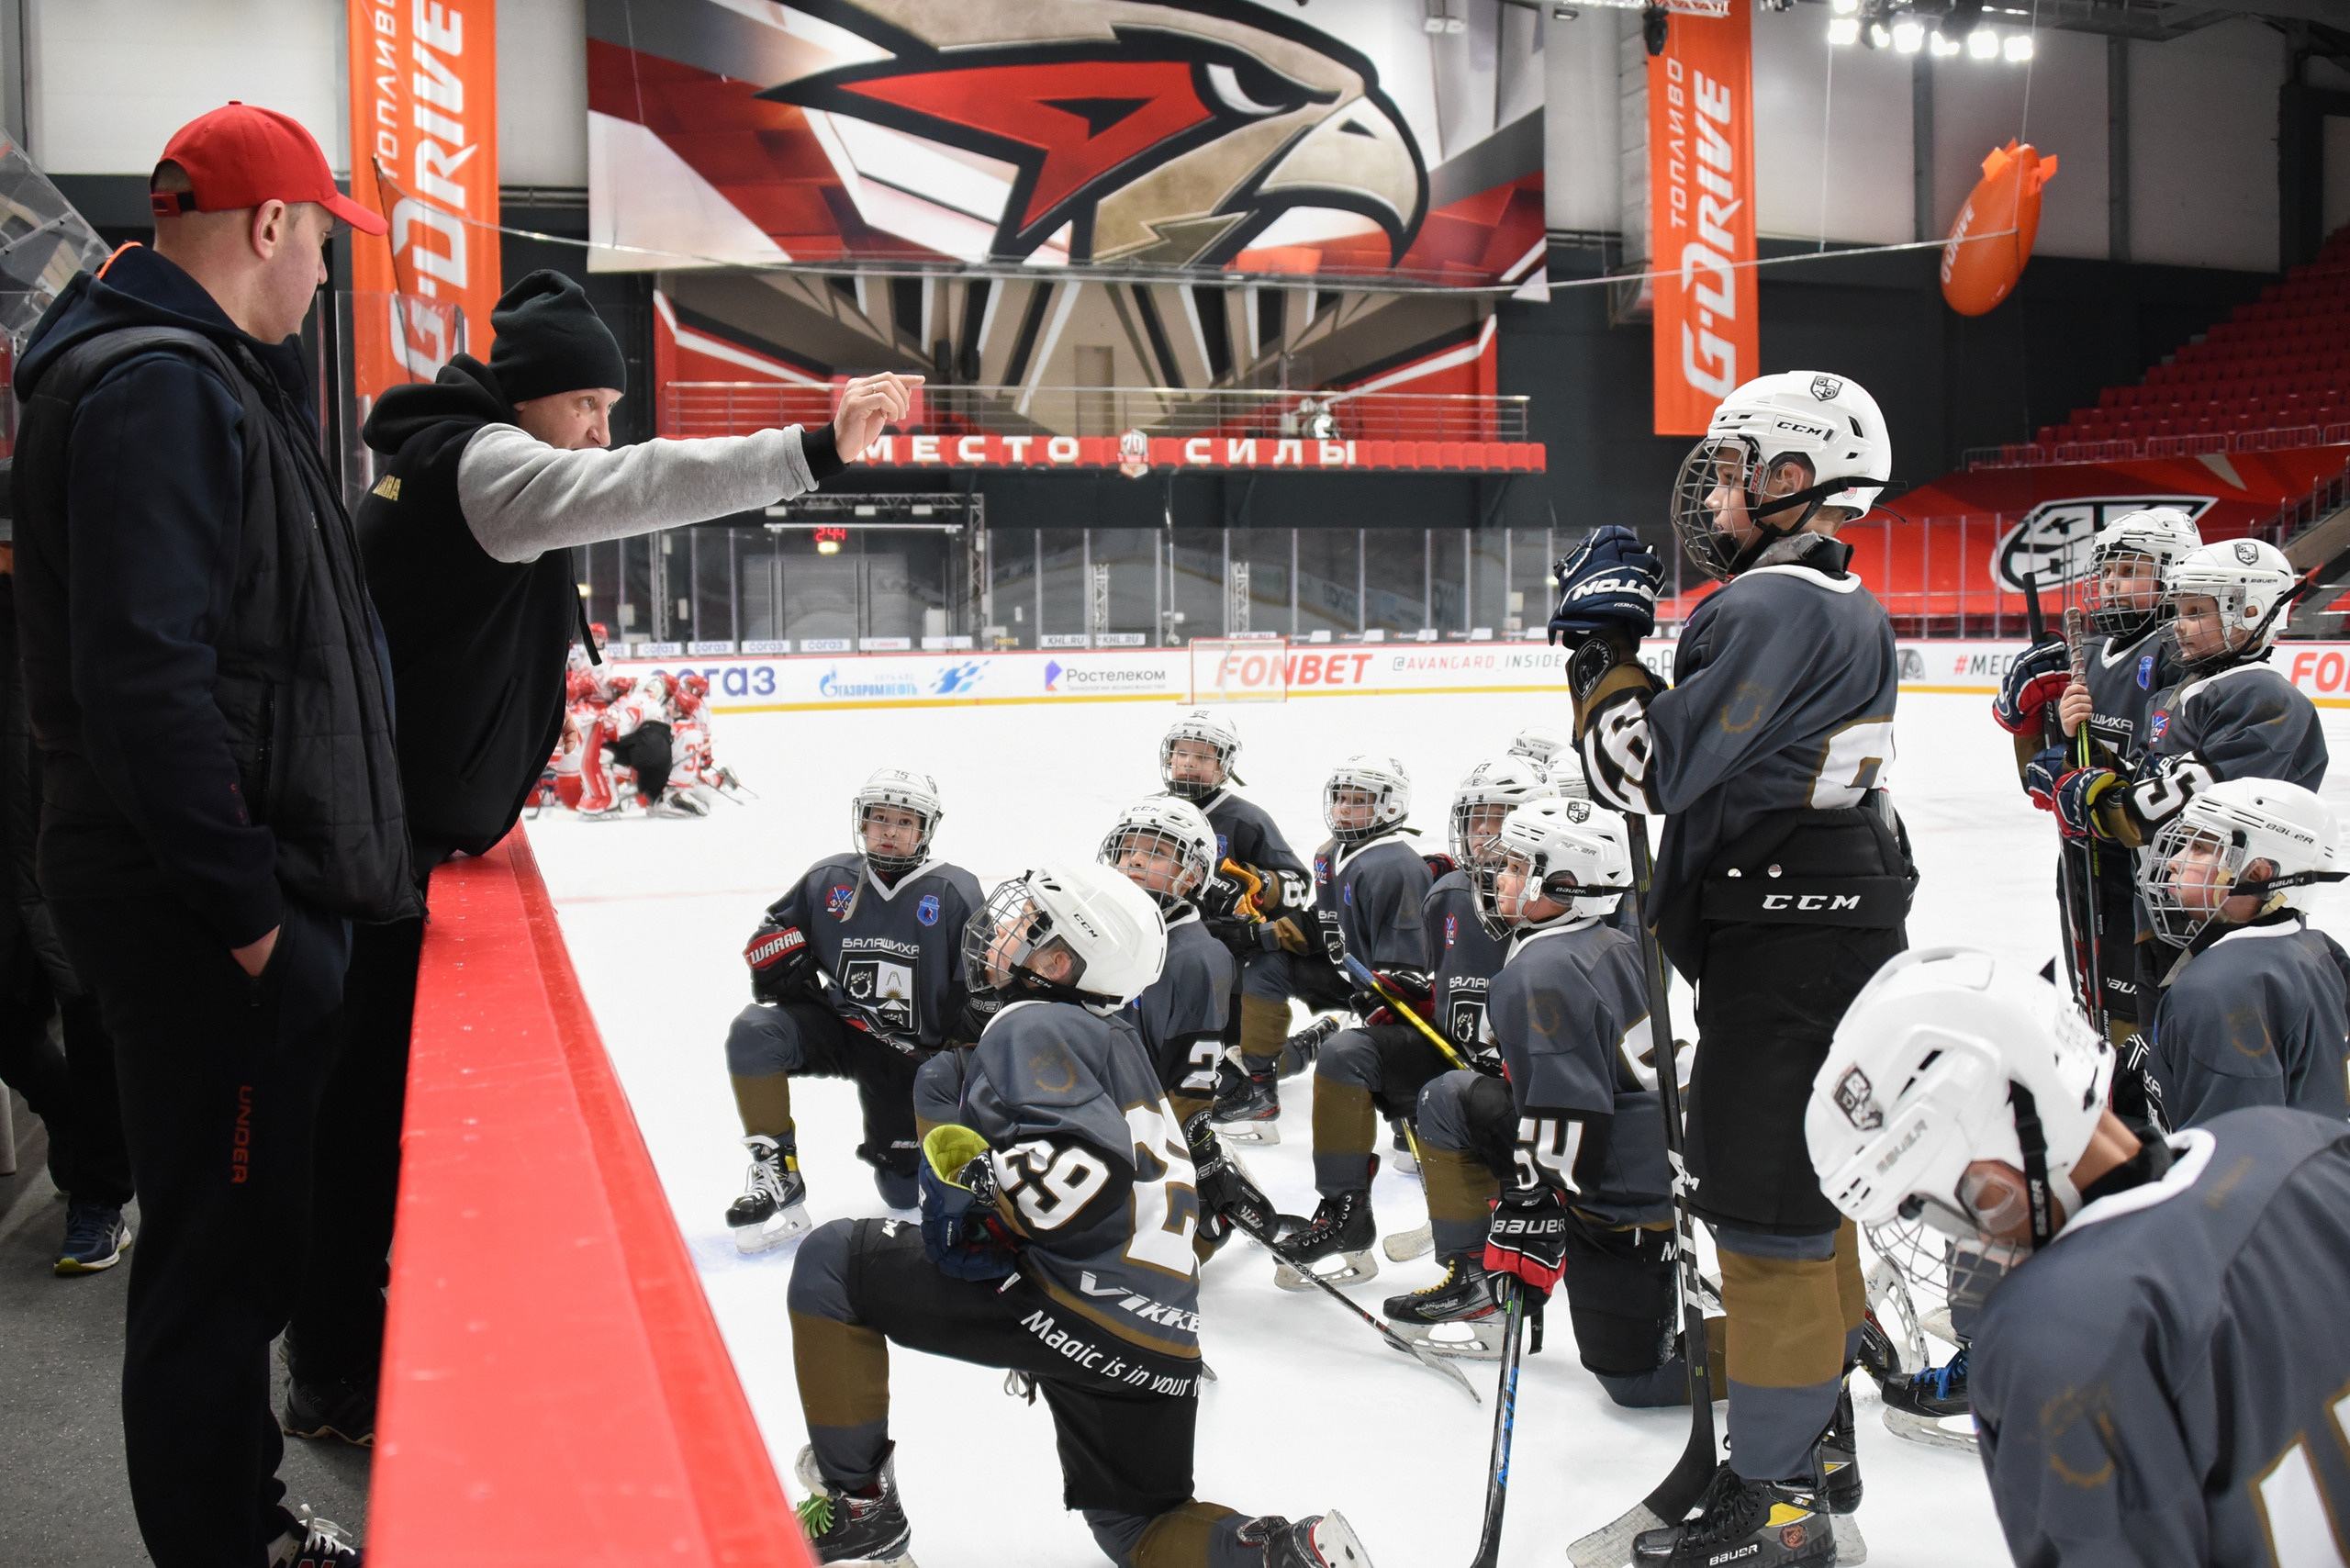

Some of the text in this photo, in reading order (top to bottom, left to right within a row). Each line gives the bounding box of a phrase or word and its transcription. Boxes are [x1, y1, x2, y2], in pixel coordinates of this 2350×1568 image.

[1667, 58, 1687, 229] ТОПЛИВО
[1776, 420, 1823, 436] CCM
[855, 434, 1357, 465] МЕСТО СИЛЫ
[1102, 633, 1139, 644] KHL.RU
[1066, 668, 1166, 682] Ростелеком
[1214, 654, 1373, 688] FONBET
[838, 683, 918, 698] ГАЗПРОМНЕФТЬ
[882, 786, 912, 797] BAUER
[1130, 805, 1162, 813] CCM
[1762, 893, 1862, 911] CCM
[1072, 912, 1099, 939] CCM
[841, 936, 920, 956] БАЛАШИХА
[230, 1084, 253, 1184] UNDER
[1492, 1217, 1567, 1235] BAUER
[1100, 1356, 1127, 1378] is
[1123, 1364, 1150, 1387] in
[1148, 1374, 1192, 1397] your
[1709, 1543, 1759, 1568] BAUER
